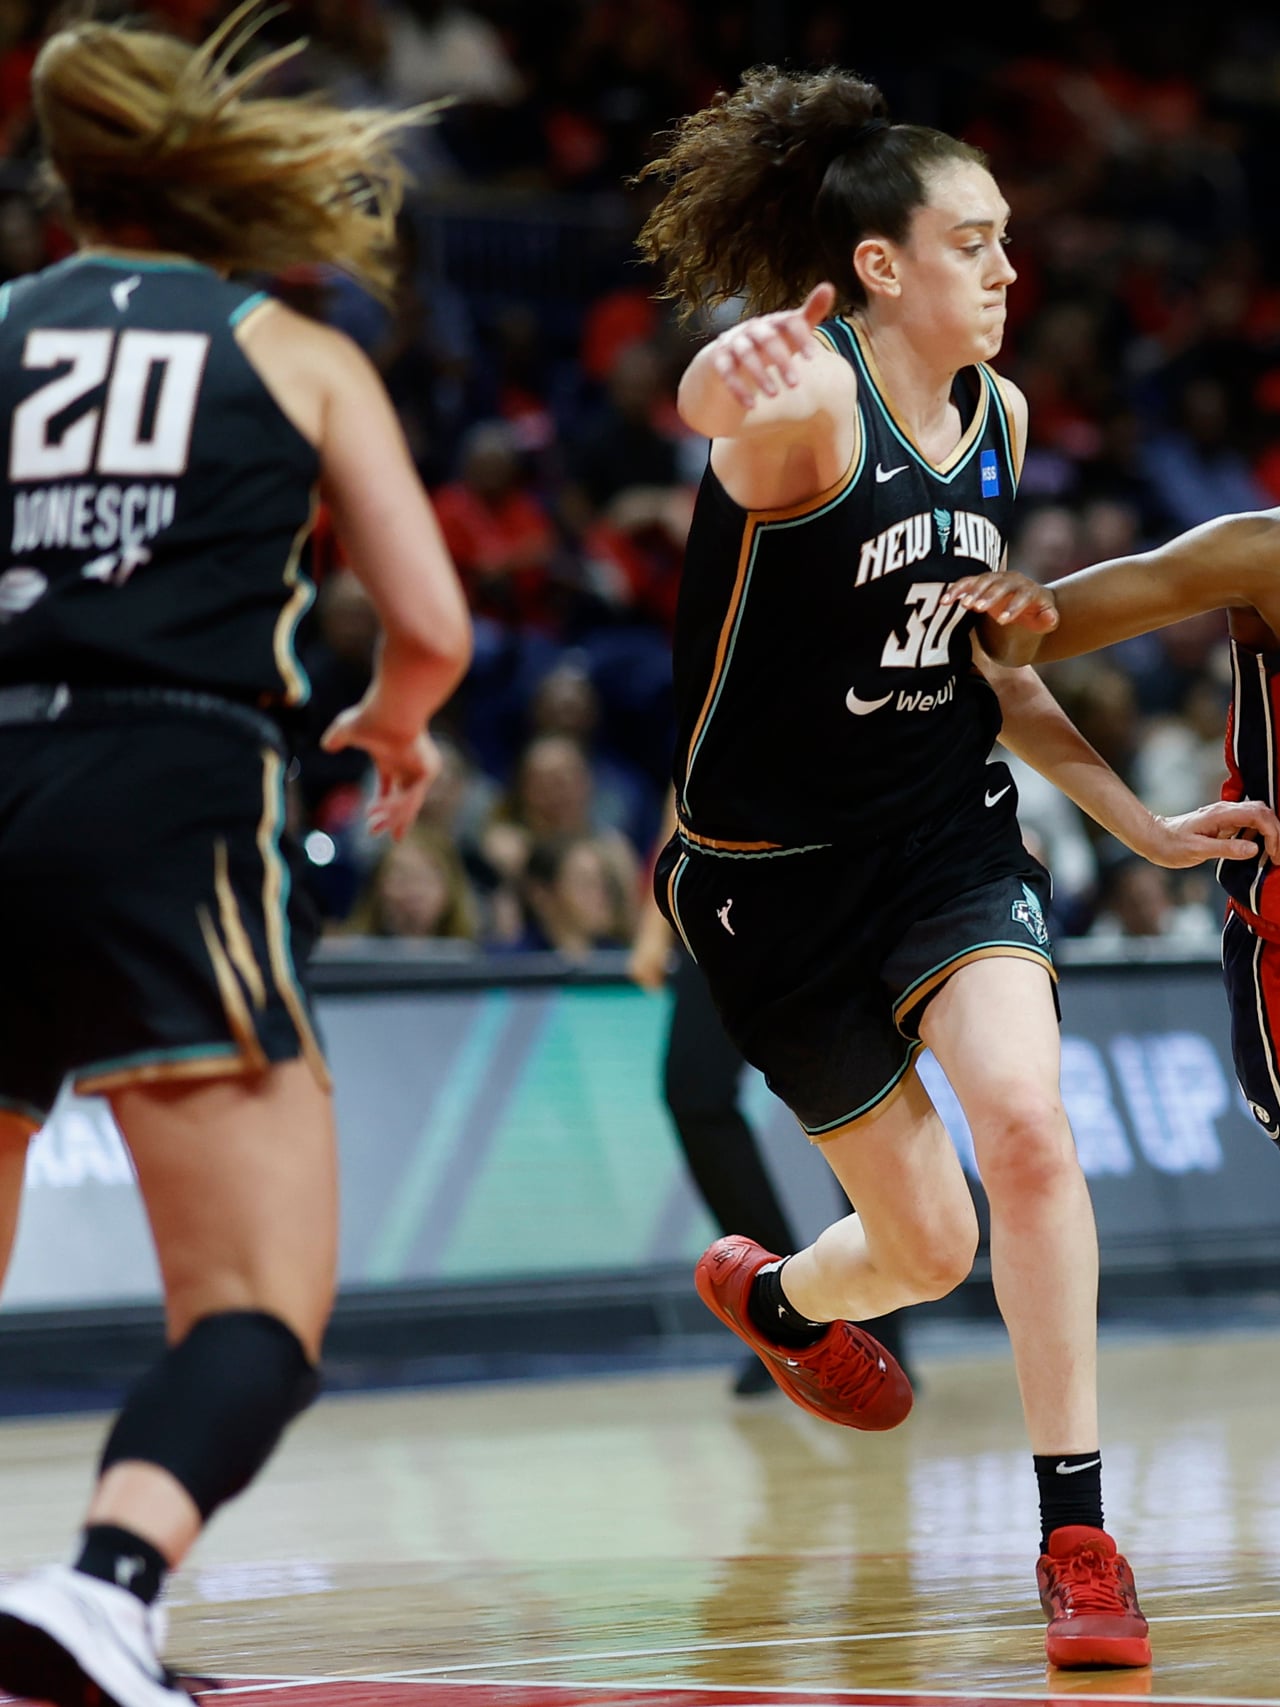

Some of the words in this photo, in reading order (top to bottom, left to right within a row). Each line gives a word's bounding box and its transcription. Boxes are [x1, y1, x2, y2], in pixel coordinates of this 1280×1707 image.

[9, 328, 210, 481] 20
[854, 512, 932, 588] NEW
[880, 582, 970, 668] 30
